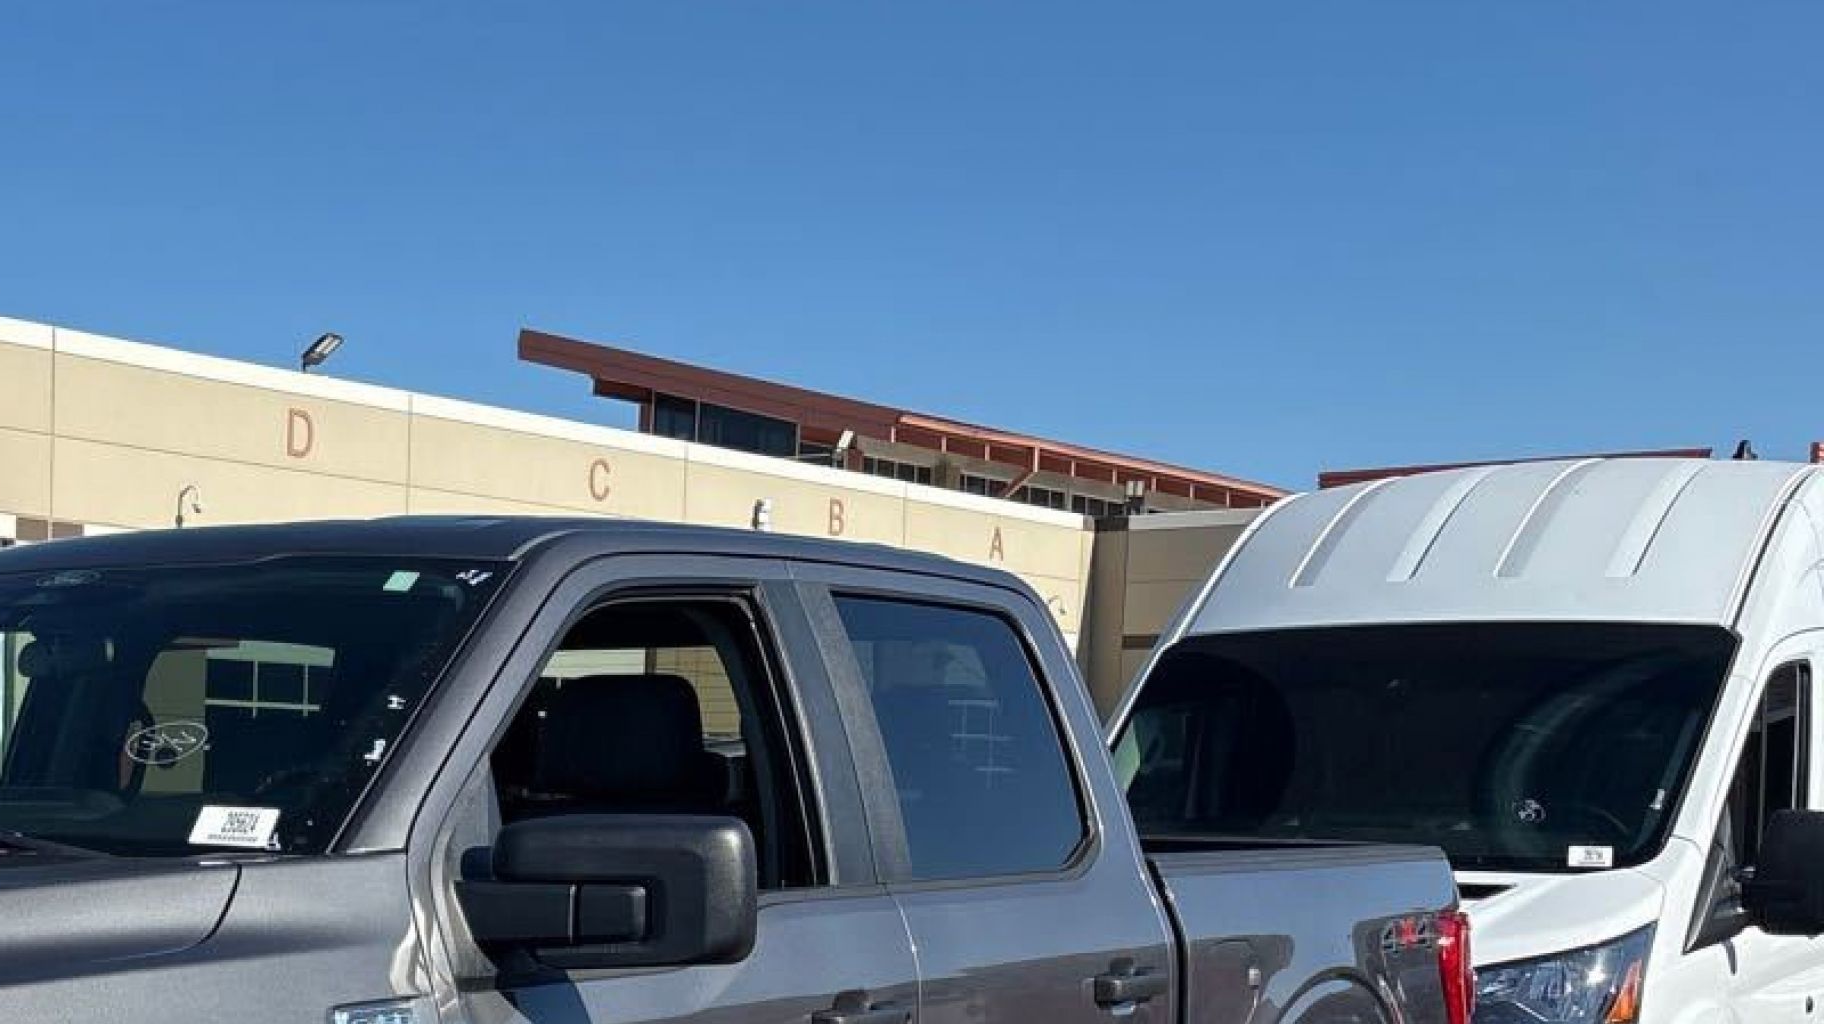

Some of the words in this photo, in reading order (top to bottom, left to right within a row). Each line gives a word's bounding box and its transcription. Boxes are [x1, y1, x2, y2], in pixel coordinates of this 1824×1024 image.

[286, 407, 313, 458] D
[589, 458, 611, 502] C
[828, 497, 845, 536] B
[988, 527, 1004, 562] A
